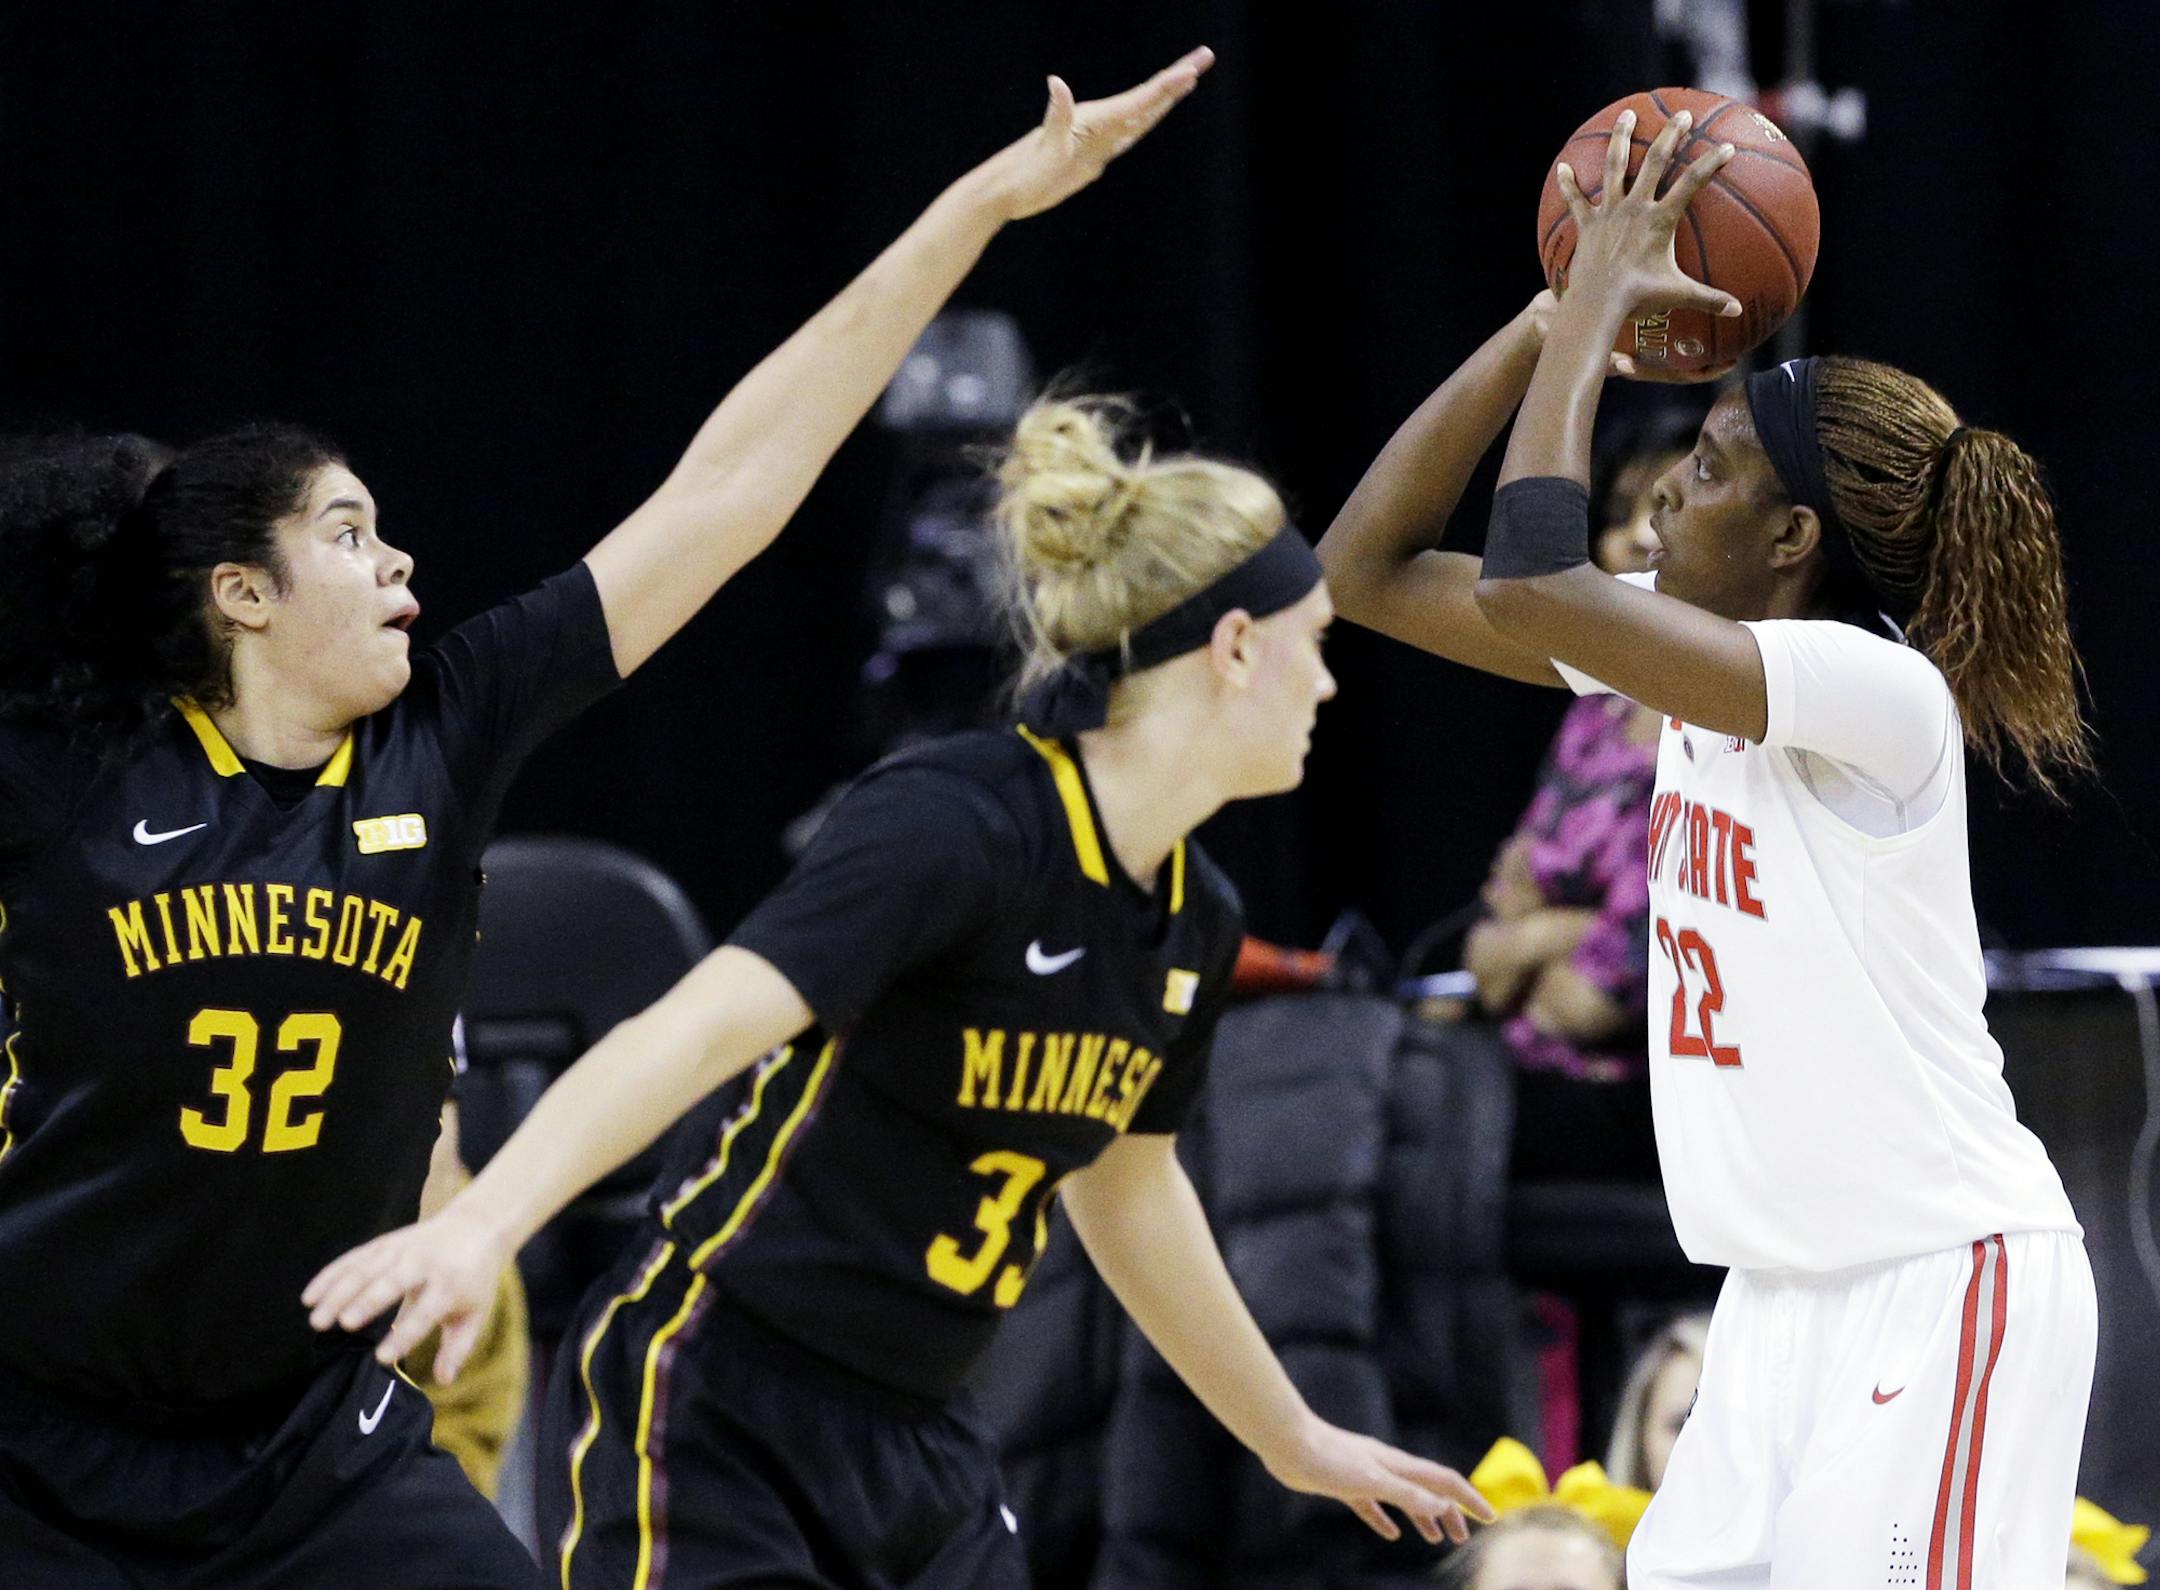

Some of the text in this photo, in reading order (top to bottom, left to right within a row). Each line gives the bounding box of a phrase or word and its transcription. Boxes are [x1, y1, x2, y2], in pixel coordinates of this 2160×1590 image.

[108, 882, 423, 990] MINNESOTA
[1655, 915, 1744, 1069] 22
[179, 1008, 342, 1153] 32
[925, 1149, 1047, 1309] 3
